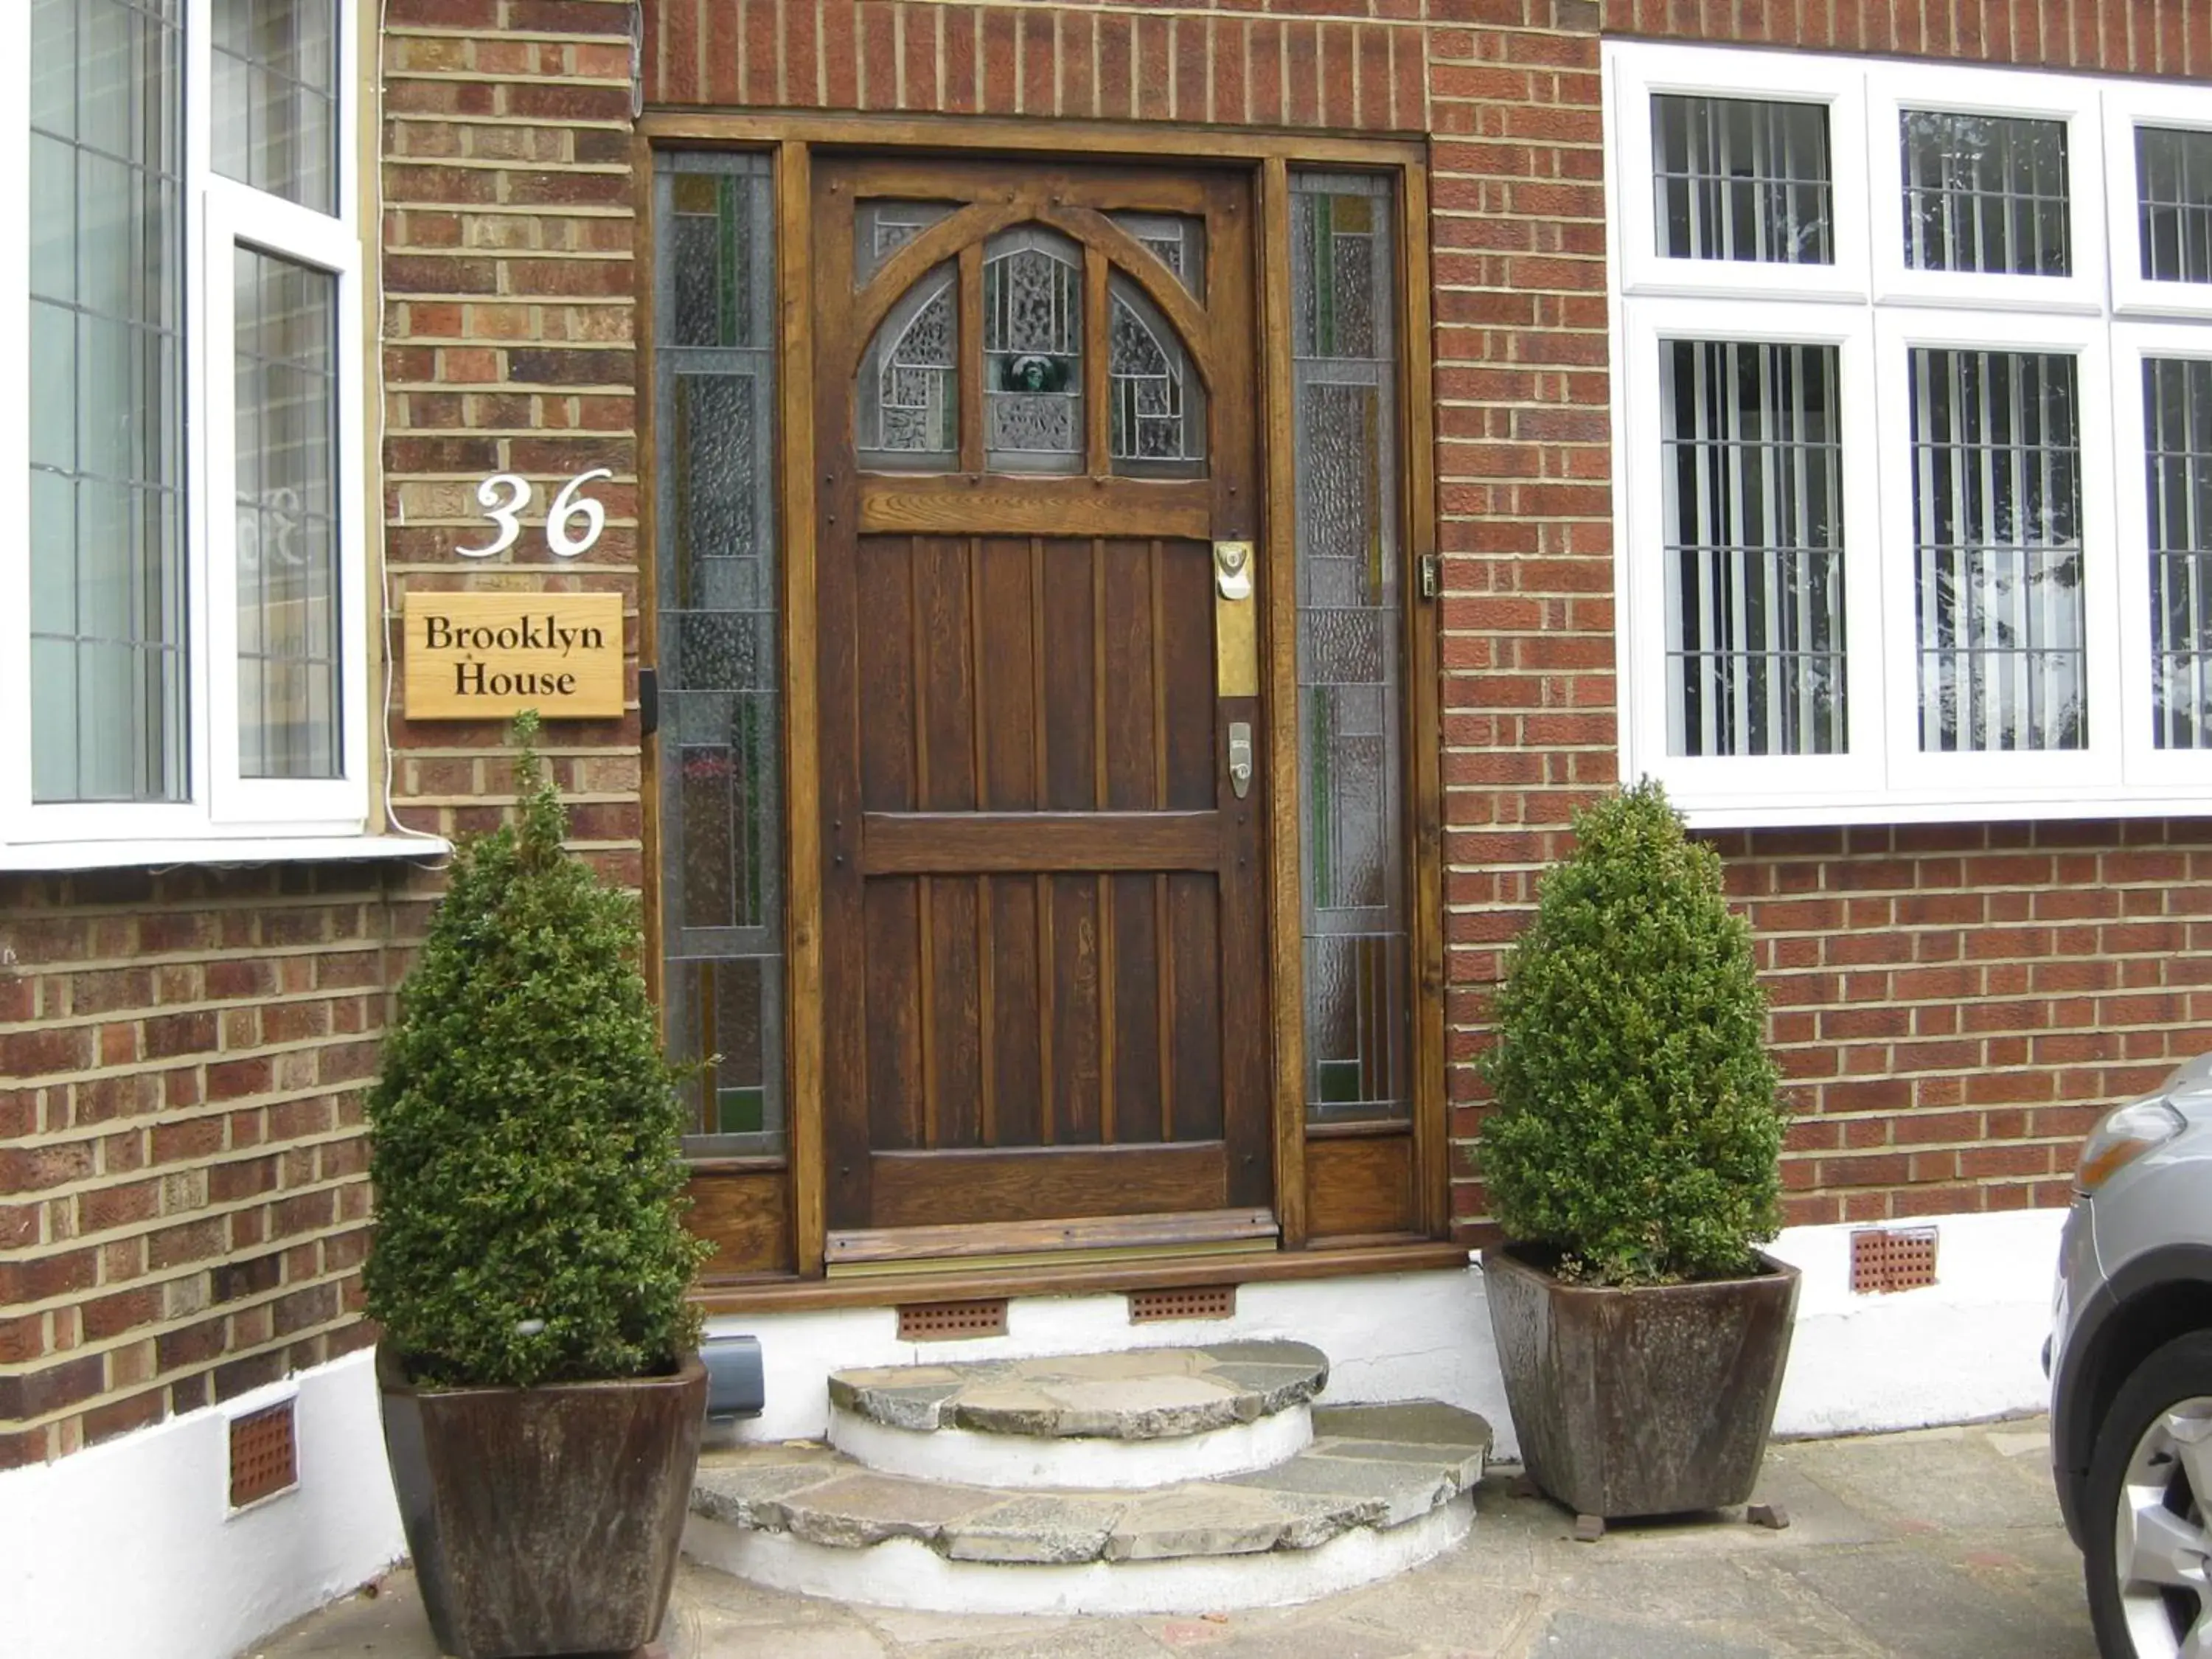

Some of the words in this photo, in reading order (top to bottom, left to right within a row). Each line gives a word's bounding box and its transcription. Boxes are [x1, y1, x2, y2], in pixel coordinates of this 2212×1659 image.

[455, 468, 613, 557] 36
[424, 615, 605, 658] Brooklyn
[454, 662, 577, 696] House
